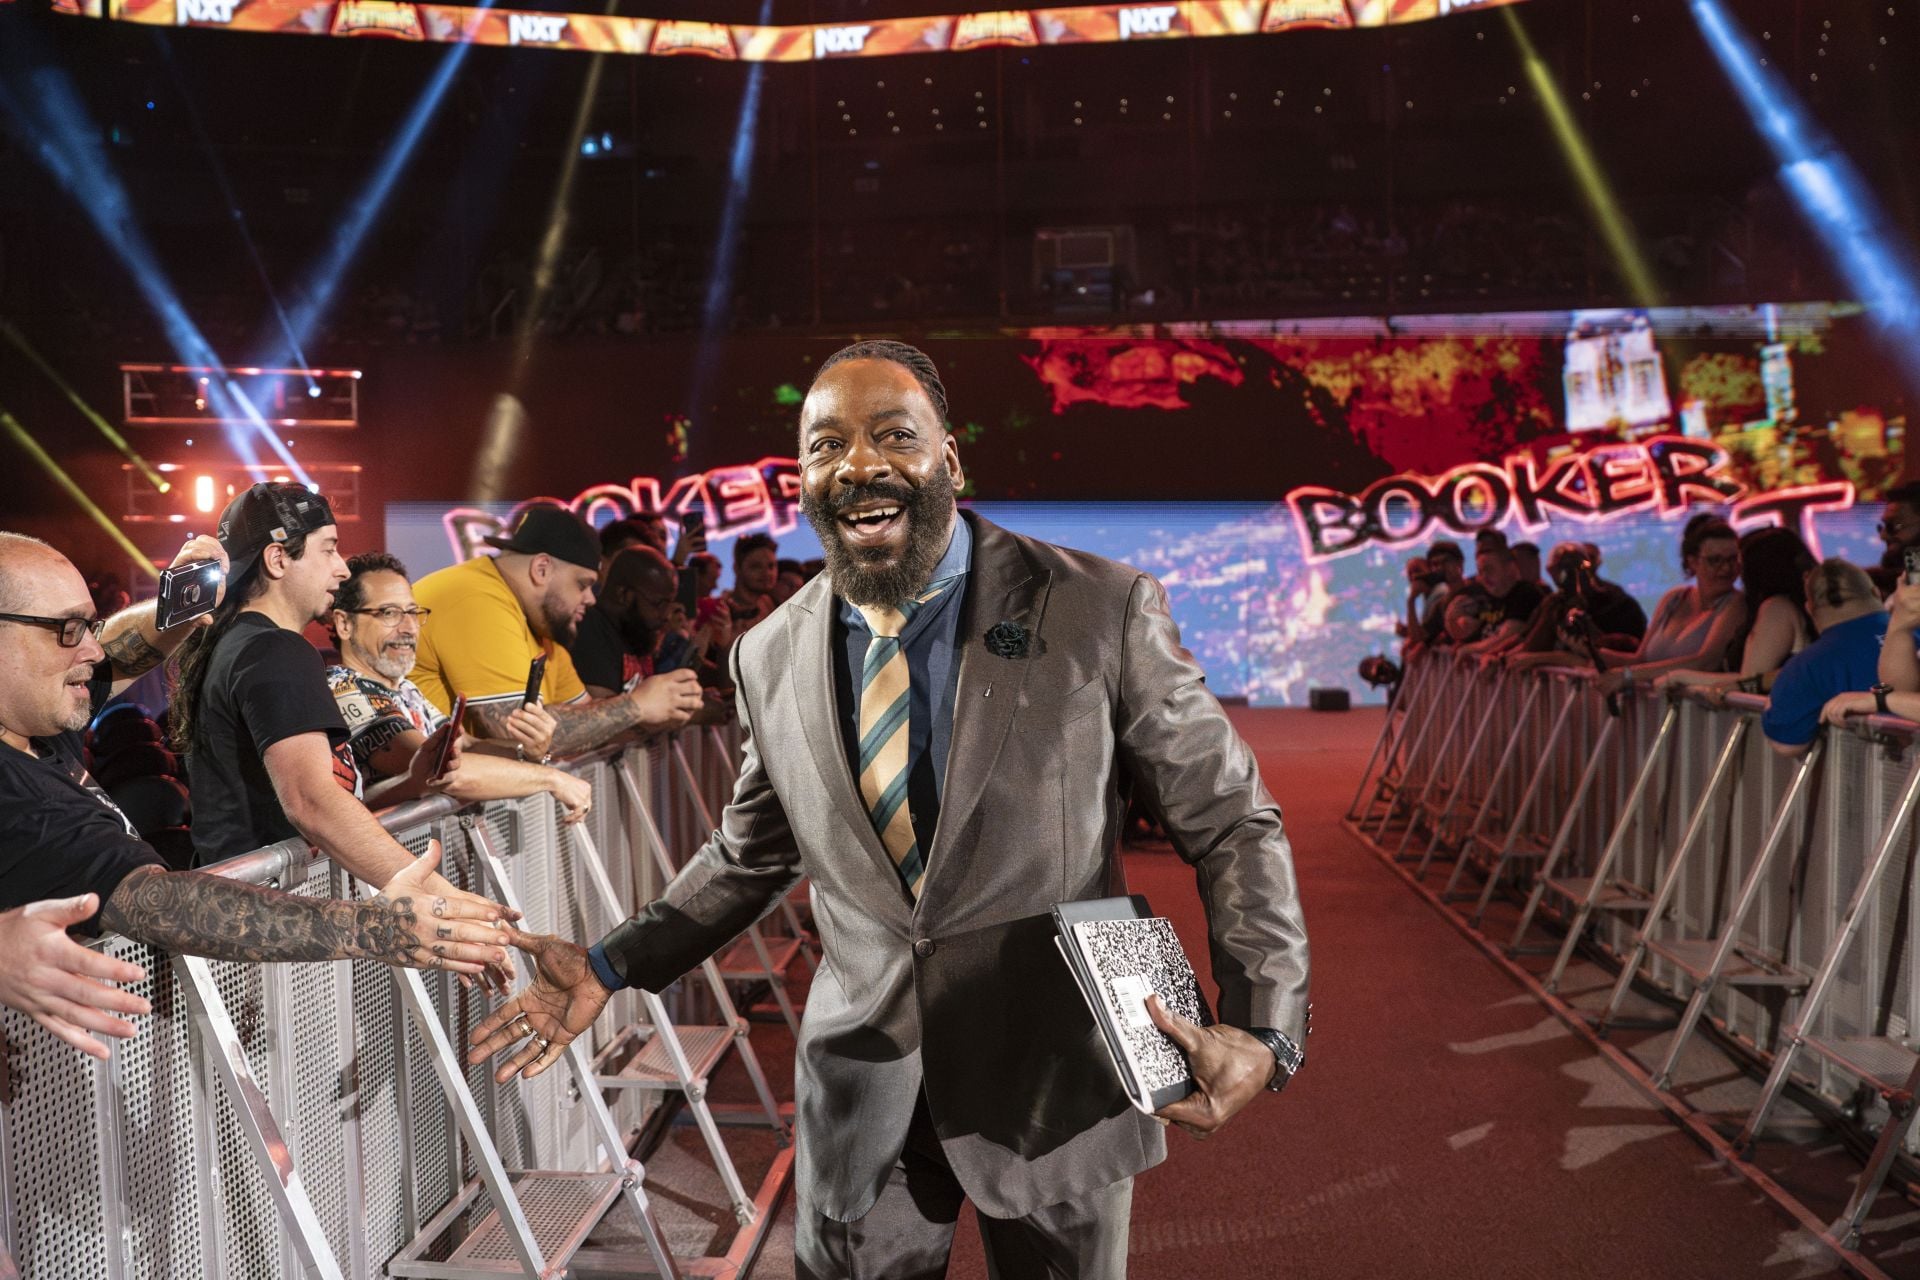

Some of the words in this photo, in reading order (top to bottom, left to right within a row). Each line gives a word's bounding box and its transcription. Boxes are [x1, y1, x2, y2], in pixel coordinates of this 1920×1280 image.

[177, 0, 240, 26] NXT
[1119, 6, 1177, 40] NXT
[509, 14, 568, 46] NXT
[815, 26, 871, 59] NXT
[1286, 435, 1747, 564] BOOKER
[1729, 480, 1855, 565] T
